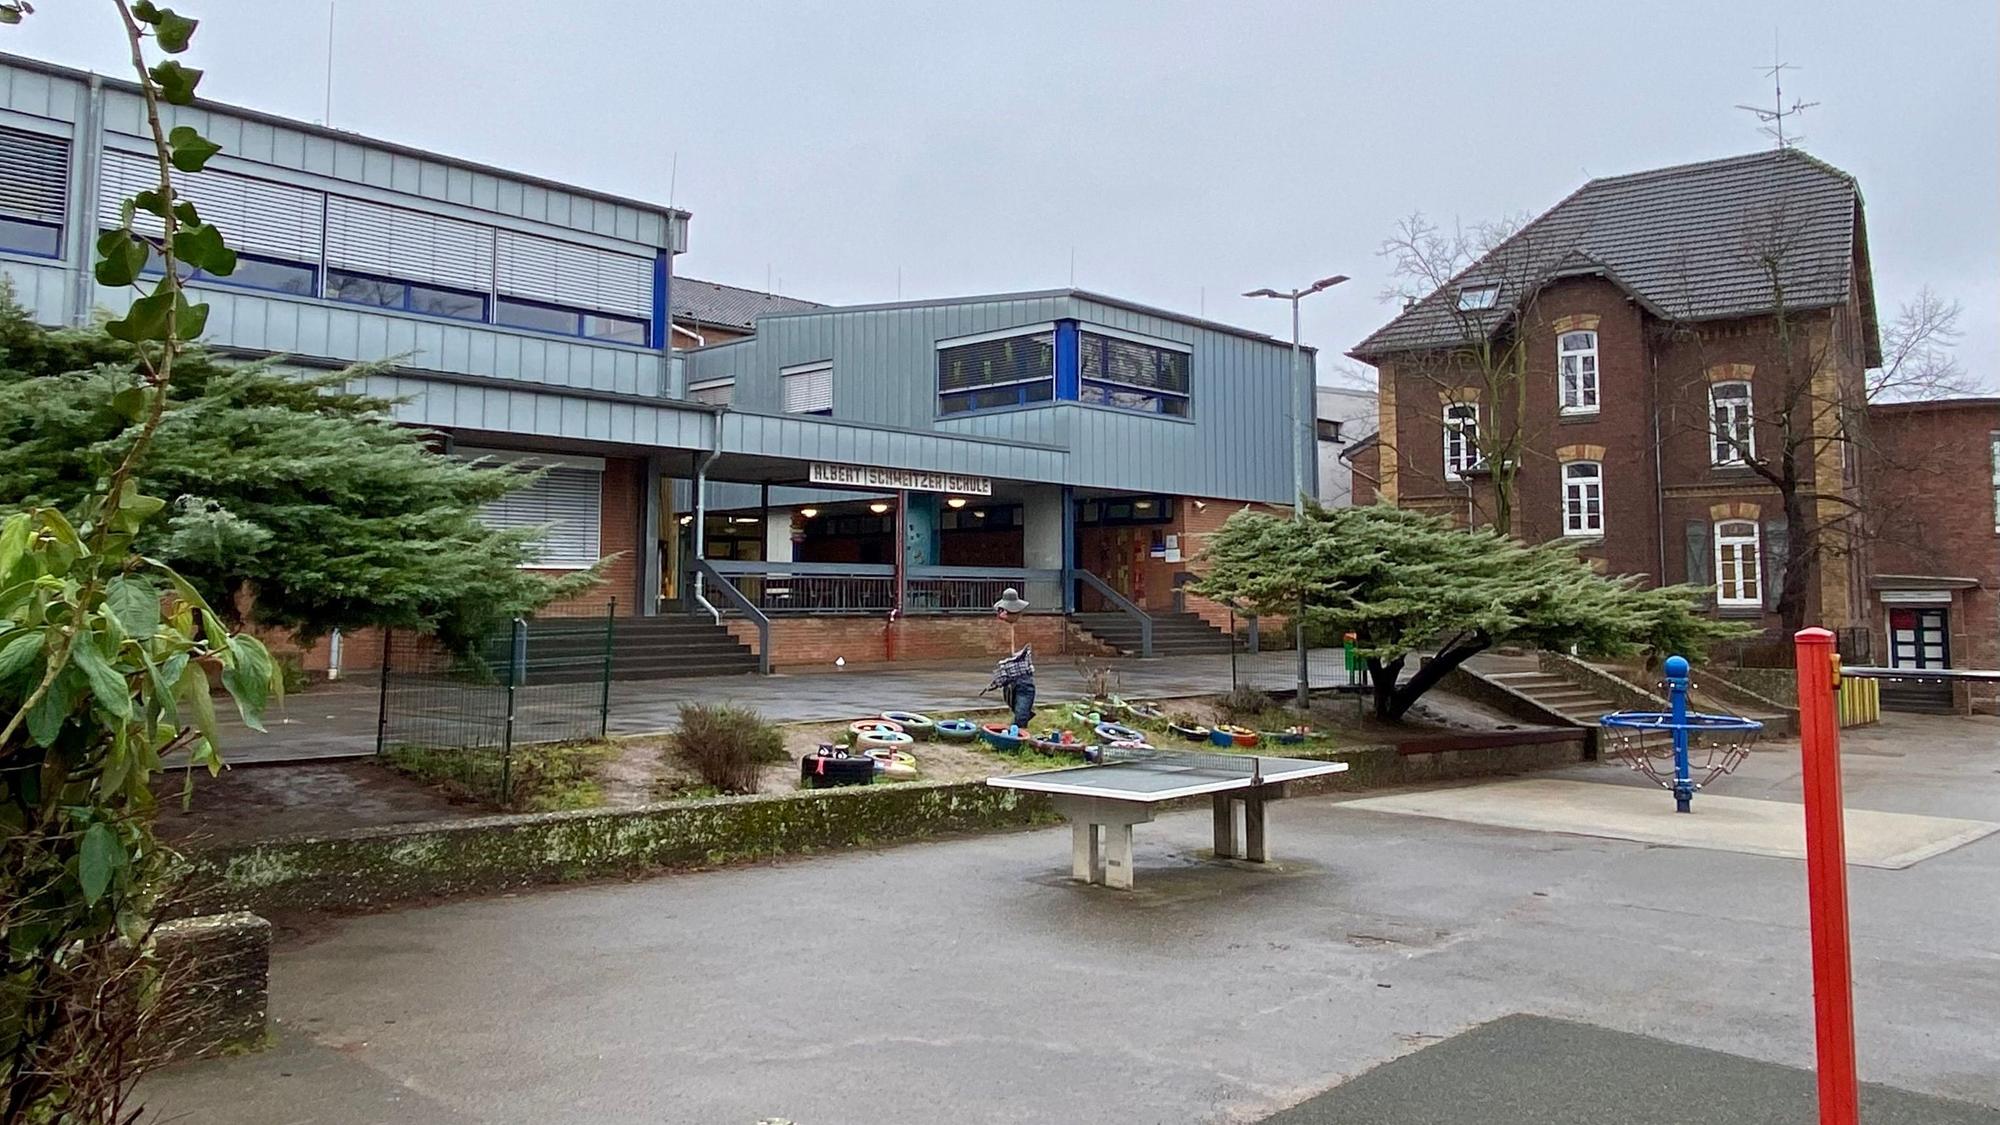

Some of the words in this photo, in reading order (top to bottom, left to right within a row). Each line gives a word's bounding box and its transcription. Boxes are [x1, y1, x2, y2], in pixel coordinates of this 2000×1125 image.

[814, 463, 862, 483] ALBERT
[869, 468, 942, 490] SCHWEITZER
[948, 475, 990, 493] SCHULE
